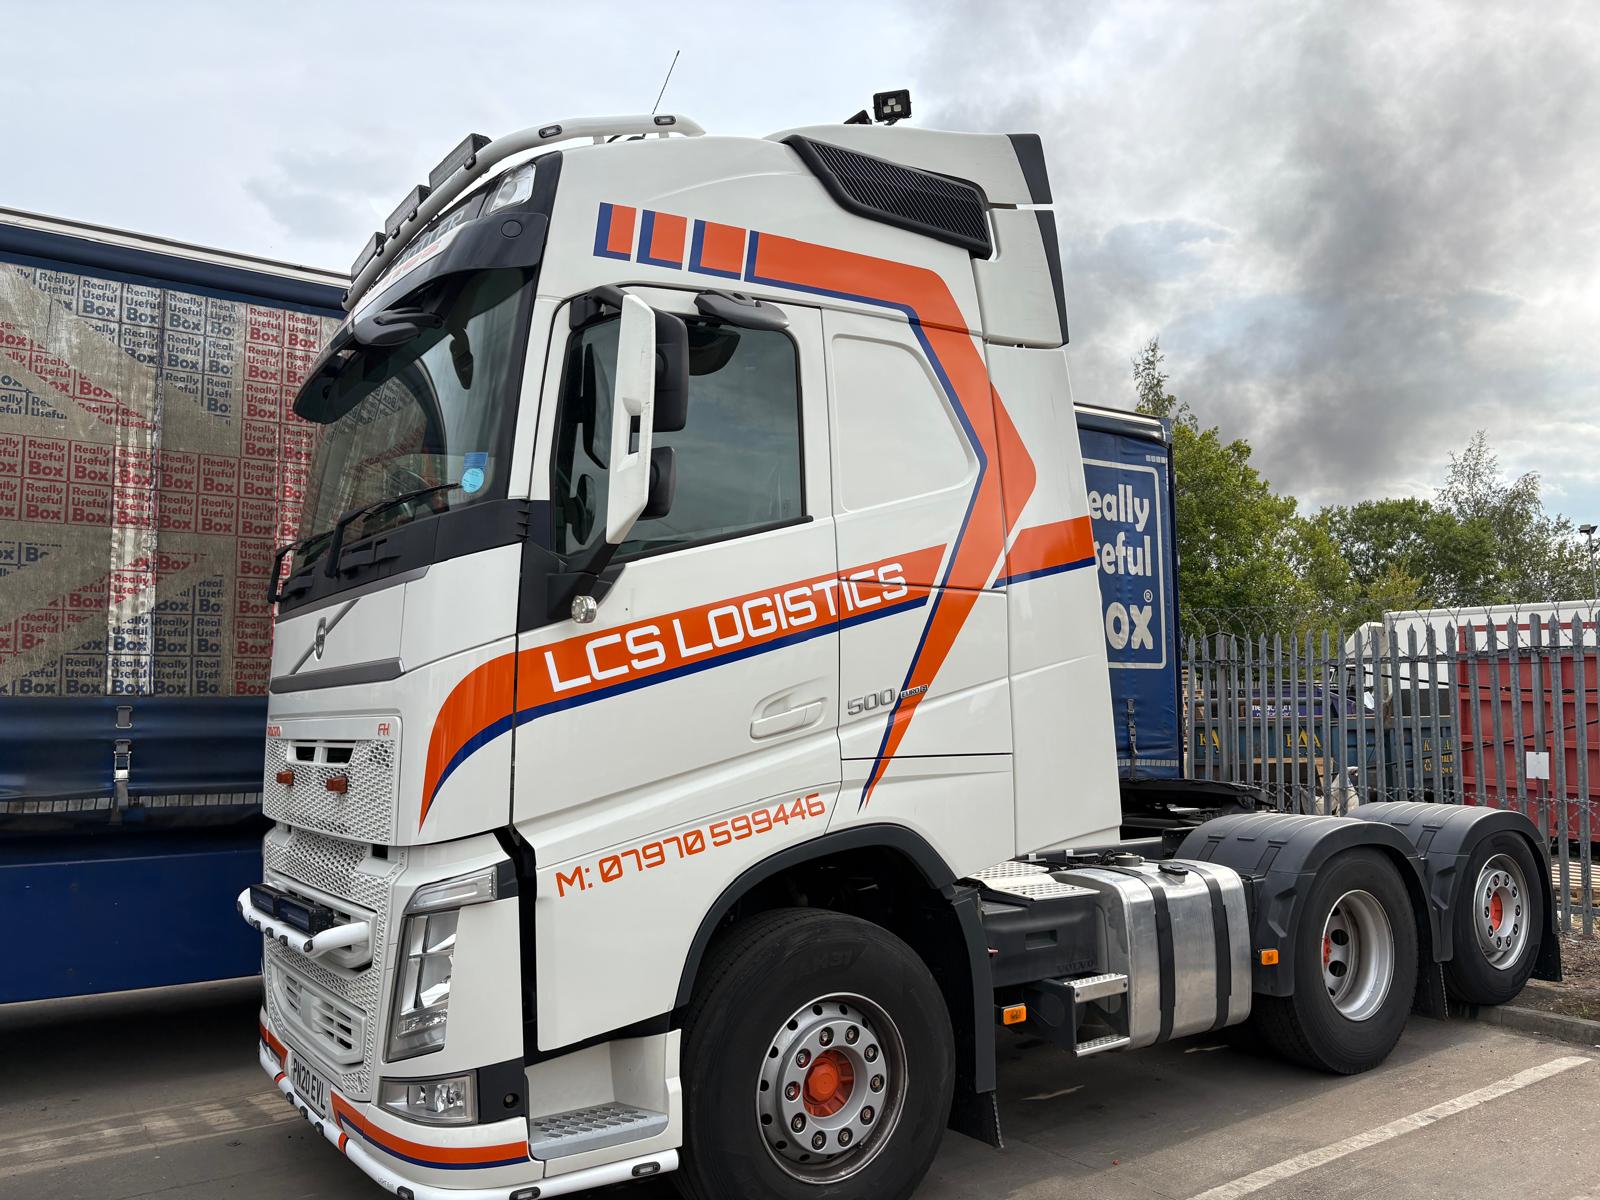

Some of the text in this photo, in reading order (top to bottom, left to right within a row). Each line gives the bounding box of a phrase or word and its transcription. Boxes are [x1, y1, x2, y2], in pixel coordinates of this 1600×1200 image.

[40, 272, 75, 286] Really
[39, 283, 74, 296] Useful
[83, 280, 118, 293] Really
[82, 289, 117, 303] Useful
[126, 288, 160, 300] Really
[169, 293, 203, 307] Really
[83, 300, 116, 317] Box
[125, 297, 161, 310] Useful
[169, 303, 202, 317] Useful
[210, 301, 235, 312] Reall
[126, 307, 159, 324] Box
[249, 308, 281, 319] Really
[288, 313, 318, 327] Really
[169, 313, 201, 331] Box
[210, 321, 234, 336] Bo
[249, 317, 280, 330] Useful
[124, 328, 158, 341] Really
[250, 327, 279, 343] Box
[288, 324, 317, 336] Useful
[124, 338, 158, 350] Useful
[167, 334, 201, 347] Really
[288, 333, 316, 349] Box
[167, 344, 200, 356] Useful
[248, 346, 279, 358] Really
[167, 353, 199, 371] Box
[208, 360, 233, 375] Bo
[247, 355, 280, 368] Useful
[35, 365, 70, 378] Useful
[248, 365, 277, 381] Box
[286, 370, 304, 384] Bo
[166, 372, 199, 385] Really
[246, 384, 277, 396] Really
[0, 394, 23, 405] ally
[207, 397, 231, 413] Bo
[246, 394, 277, 406] Useful
[0, 405, 21, 414] eful
[32, 407, 67, 419] Usefu
[247, 404, 276, 419] Box
[245, 423, 276, 435] Really
[0, 438, 19, 448] ally
[245, 433, 276, 444] Useful
[28, 440, 65, 452] Really
[74, 445, 110, 457] Really
[245, 442, 275, 457] Box
[28, 450, 64, 462] Useful
[74, 454, 109, 466] Useful
[119, 449, 152, 461] Really
[161, 453, 195, 465] Really
[284, 446, 312, 461] Box
[29, 461, 63, 477] Box
[161, 464, 195, 475] Useful
[203, 457, 236, 469] Really
[243, 462, 275, 473] Really
[75, 465, 109, 481] Box
[119, 469, 151, 486] Box
[203, 467, 235, 478] Useful
[243, 471, 274, 482] Useful
[26, 482, 63, 495] Really
[162, 474, 194, 490] Box
[203, 477, 234, 493] Box
[72, 486, 108, 499] Really
[243, 482, 273, 496] Box
[282, 485, 304, 499] Bo
[26, 493, 62, 505] Useful
[72, 497, 107, 508] Useful
[160, 494, 193, 506] Really
[201, 498, 234, 509] Really
[26, 503, 61, 520] Box
[160, 504, 193, 515] Useful
[201, 507, 233, 518] Useful
[242, 501, 273, 513] Really
[1088, 484, 1149, 532] eally
[72, 507, 106, 523] Box
[160, 514, 192, 529] Box
[242, 511, 273, 521] Useful
[202, 517, 232, 532] Box
[242, 520, 272, 535] Box
[240, 541, 272, 552] Really
[240, 550, 271, 560] Useful
[1095, 532, 1152, 576] eful
[240, 561, 271, 574] Box
[69, 593, 103, 608] Box
[199, 599, 223, 612] Bo
[239, 601, 268, 614] Box
[21, 623, 59, 633] Useful
[237, 621, 269, 631] Really
[544, 563, 908, 692] LCS LOGISTICS
[1105, 602, 1154, 650] ox
[237, 630, 268, 639] Useful
[113, 636, 147, 651] Box
[155, 638, 187, 652] Box
[197, 639, 220, 652] Bo
[237, 641, 268, 654] Box
[65, 658, 103, 668] Really
[111, 659, 147, 669] Really
[235, 662, 267, 671] Really
[65, 669, 103, 678] Useful
[111, 669, 147, 679] Useful
[235, 671, 267, 680] Useful
[20, 679, 56, 694] Box
[66, 679, 101, 694] Box
[112, 680, 146, 695] Box
[154, 681, 186, 694] Box
[196, 681, 219, 694] Bo
[235, 682, 266, 694] Box
[847, 688, 895, 715] 500
[555, 793, 826, 897] M: 07970 599446
[293, 1058, 325, 1110] PN20 EVL
